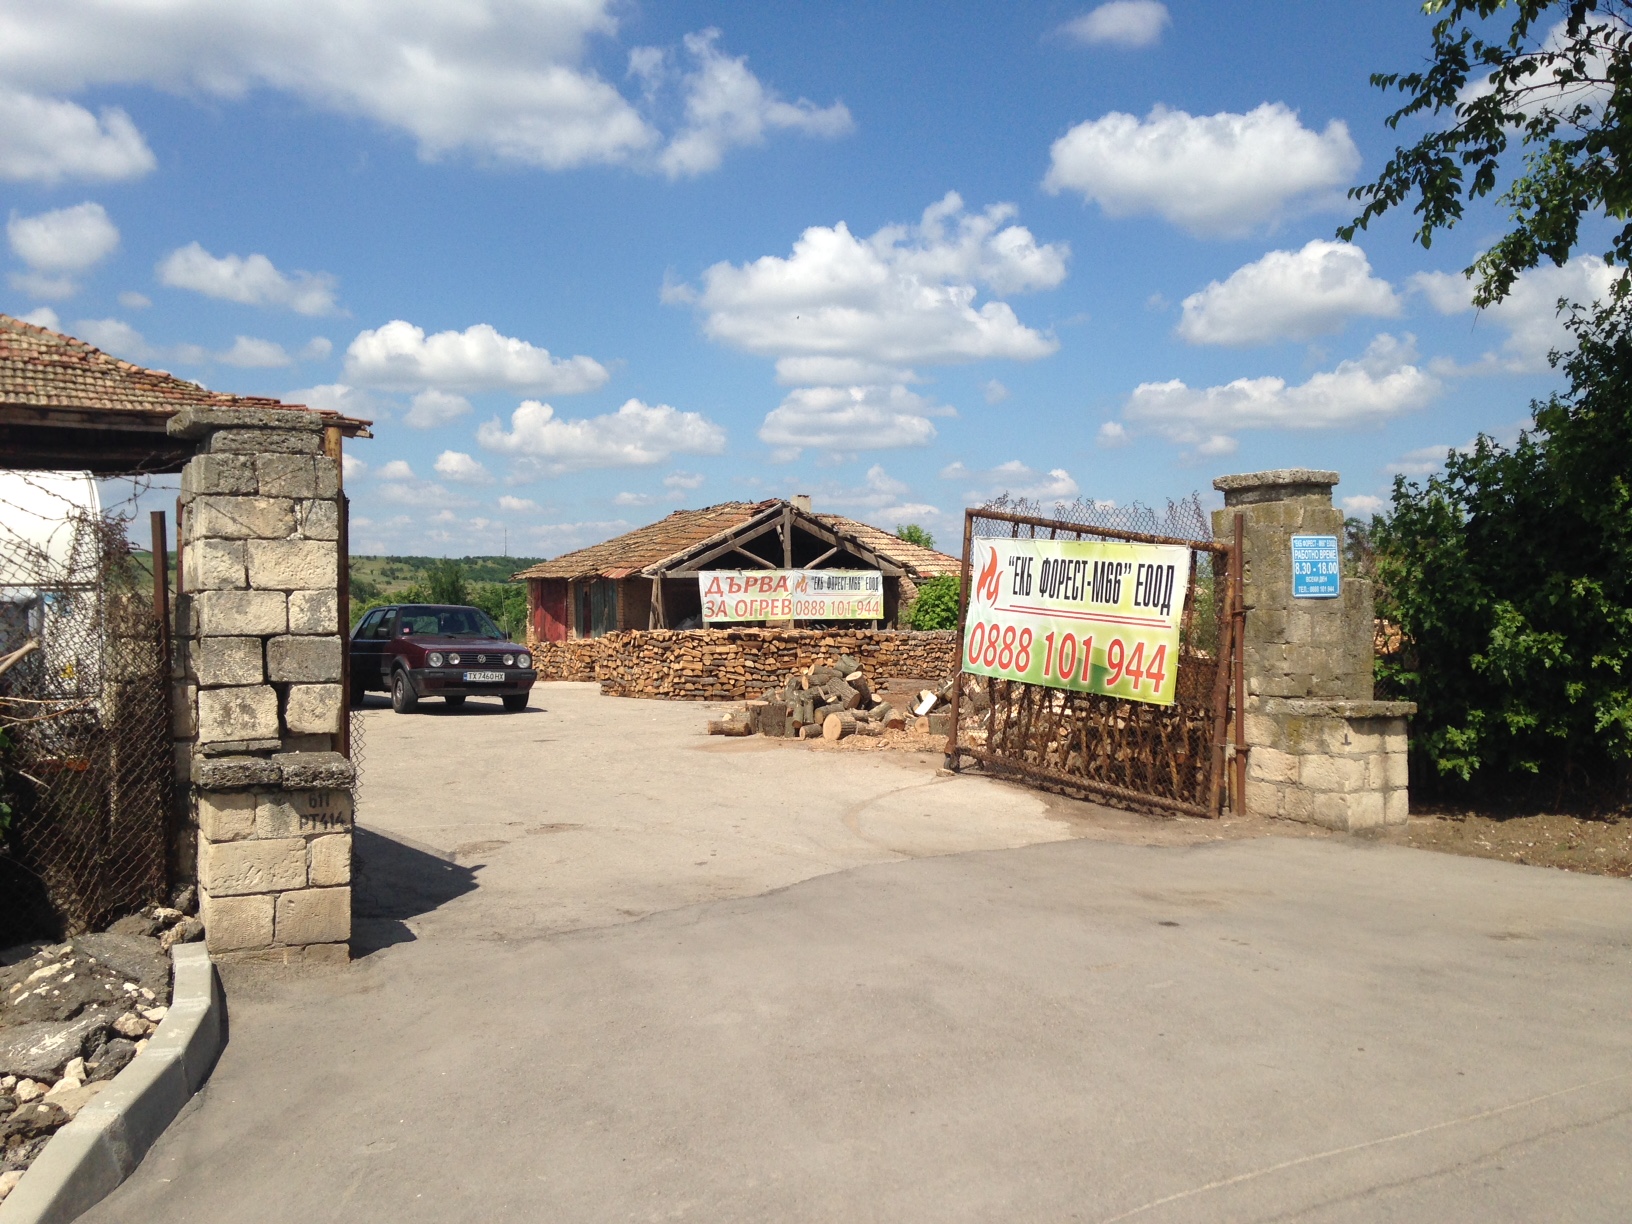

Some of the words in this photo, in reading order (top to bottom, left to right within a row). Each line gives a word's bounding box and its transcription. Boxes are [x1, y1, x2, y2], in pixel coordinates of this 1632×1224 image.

[1295, 550, 1318, 559] РАБОТНО
[1320, 550, 1336, 559] ВРЕМЕ
[1295, 562, 1311, 574] 8.30
[1318, 562, 1337, 574] 18.00
[704, 575, 790, 598] ДЪРВА
[1134, 563, 1175, 616] ЕООД
[704, 600, 728, 618] ЗА
[734, 598, 792, 617] ОГРЕВ
[795, 600, 826, 616] 0888
[831, 600, 851, 616] 101
[857, 600, 880, 616] 944
[968, 621, 1033, 673] 0888
[1043, 631, 1093, 682] 101
[1106, 638, 1167, 693] 944
